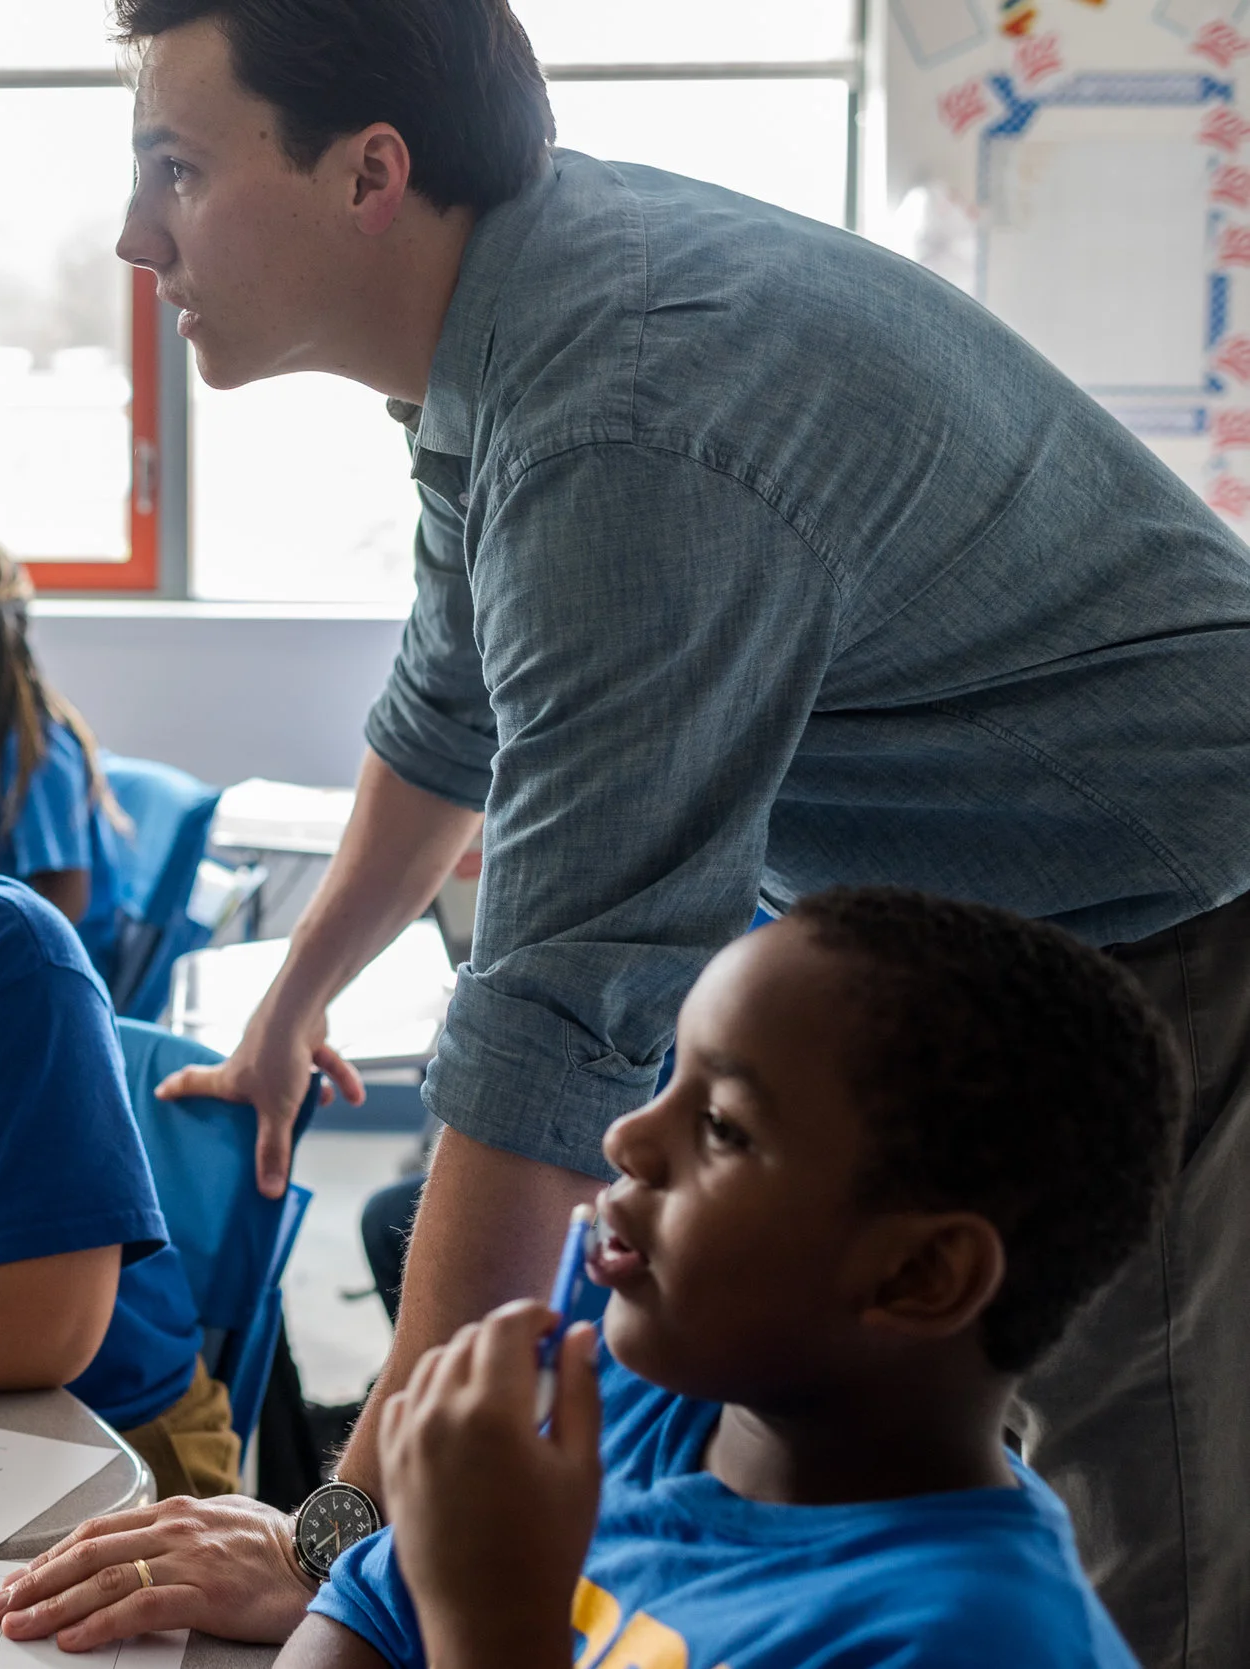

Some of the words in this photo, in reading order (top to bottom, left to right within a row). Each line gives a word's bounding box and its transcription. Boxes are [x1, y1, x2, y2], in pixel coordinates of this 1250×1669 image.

[343, 1501, 351, 1510] 8
[320, 1506, 327, 1515] 6
[354, 1508, 362, 1516] 9
[311, 1519, 320, 1528] 5
[356, 1521, 366, 1532] 10
[310, 1533, 317, 1543] 4
